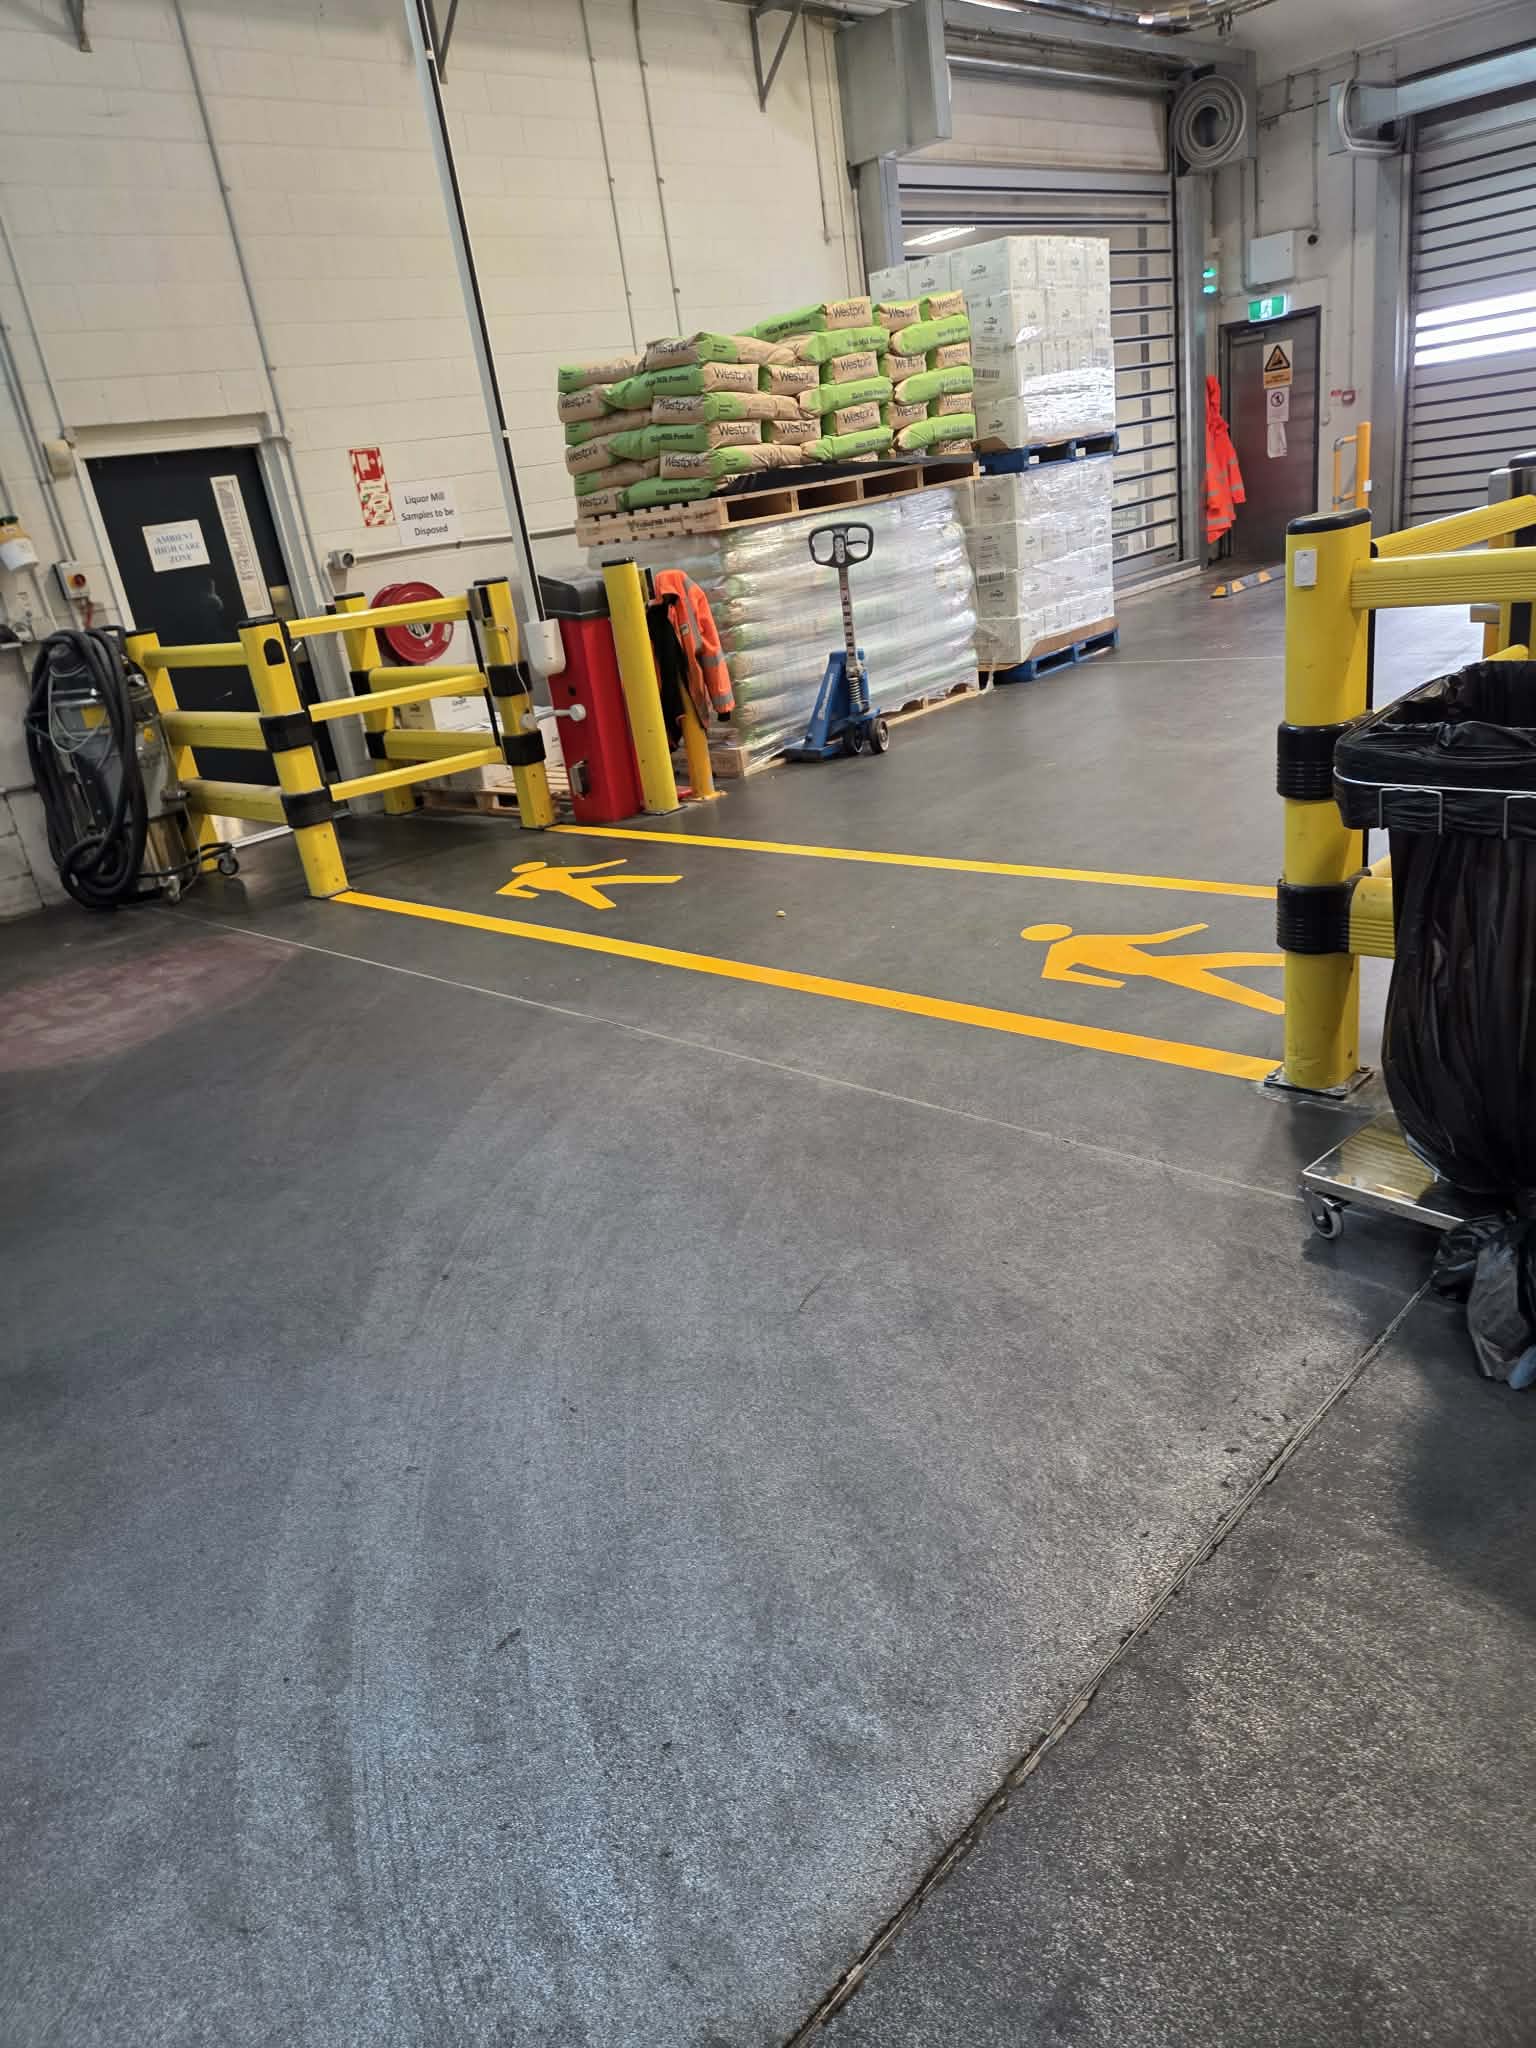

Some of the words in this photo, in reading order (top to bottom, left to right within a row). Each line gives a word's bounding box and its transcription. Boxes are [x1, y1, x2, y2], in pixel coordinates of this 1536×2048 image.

[404, 495, 429, 505] Liquor
[430, 491, 445, 502] Mill
[401, 511, 434, 522] Samples
[434, 509, 443, 518] to
[443, 508, 455, 517] be
[414, 523, 449, 537] Disposed
